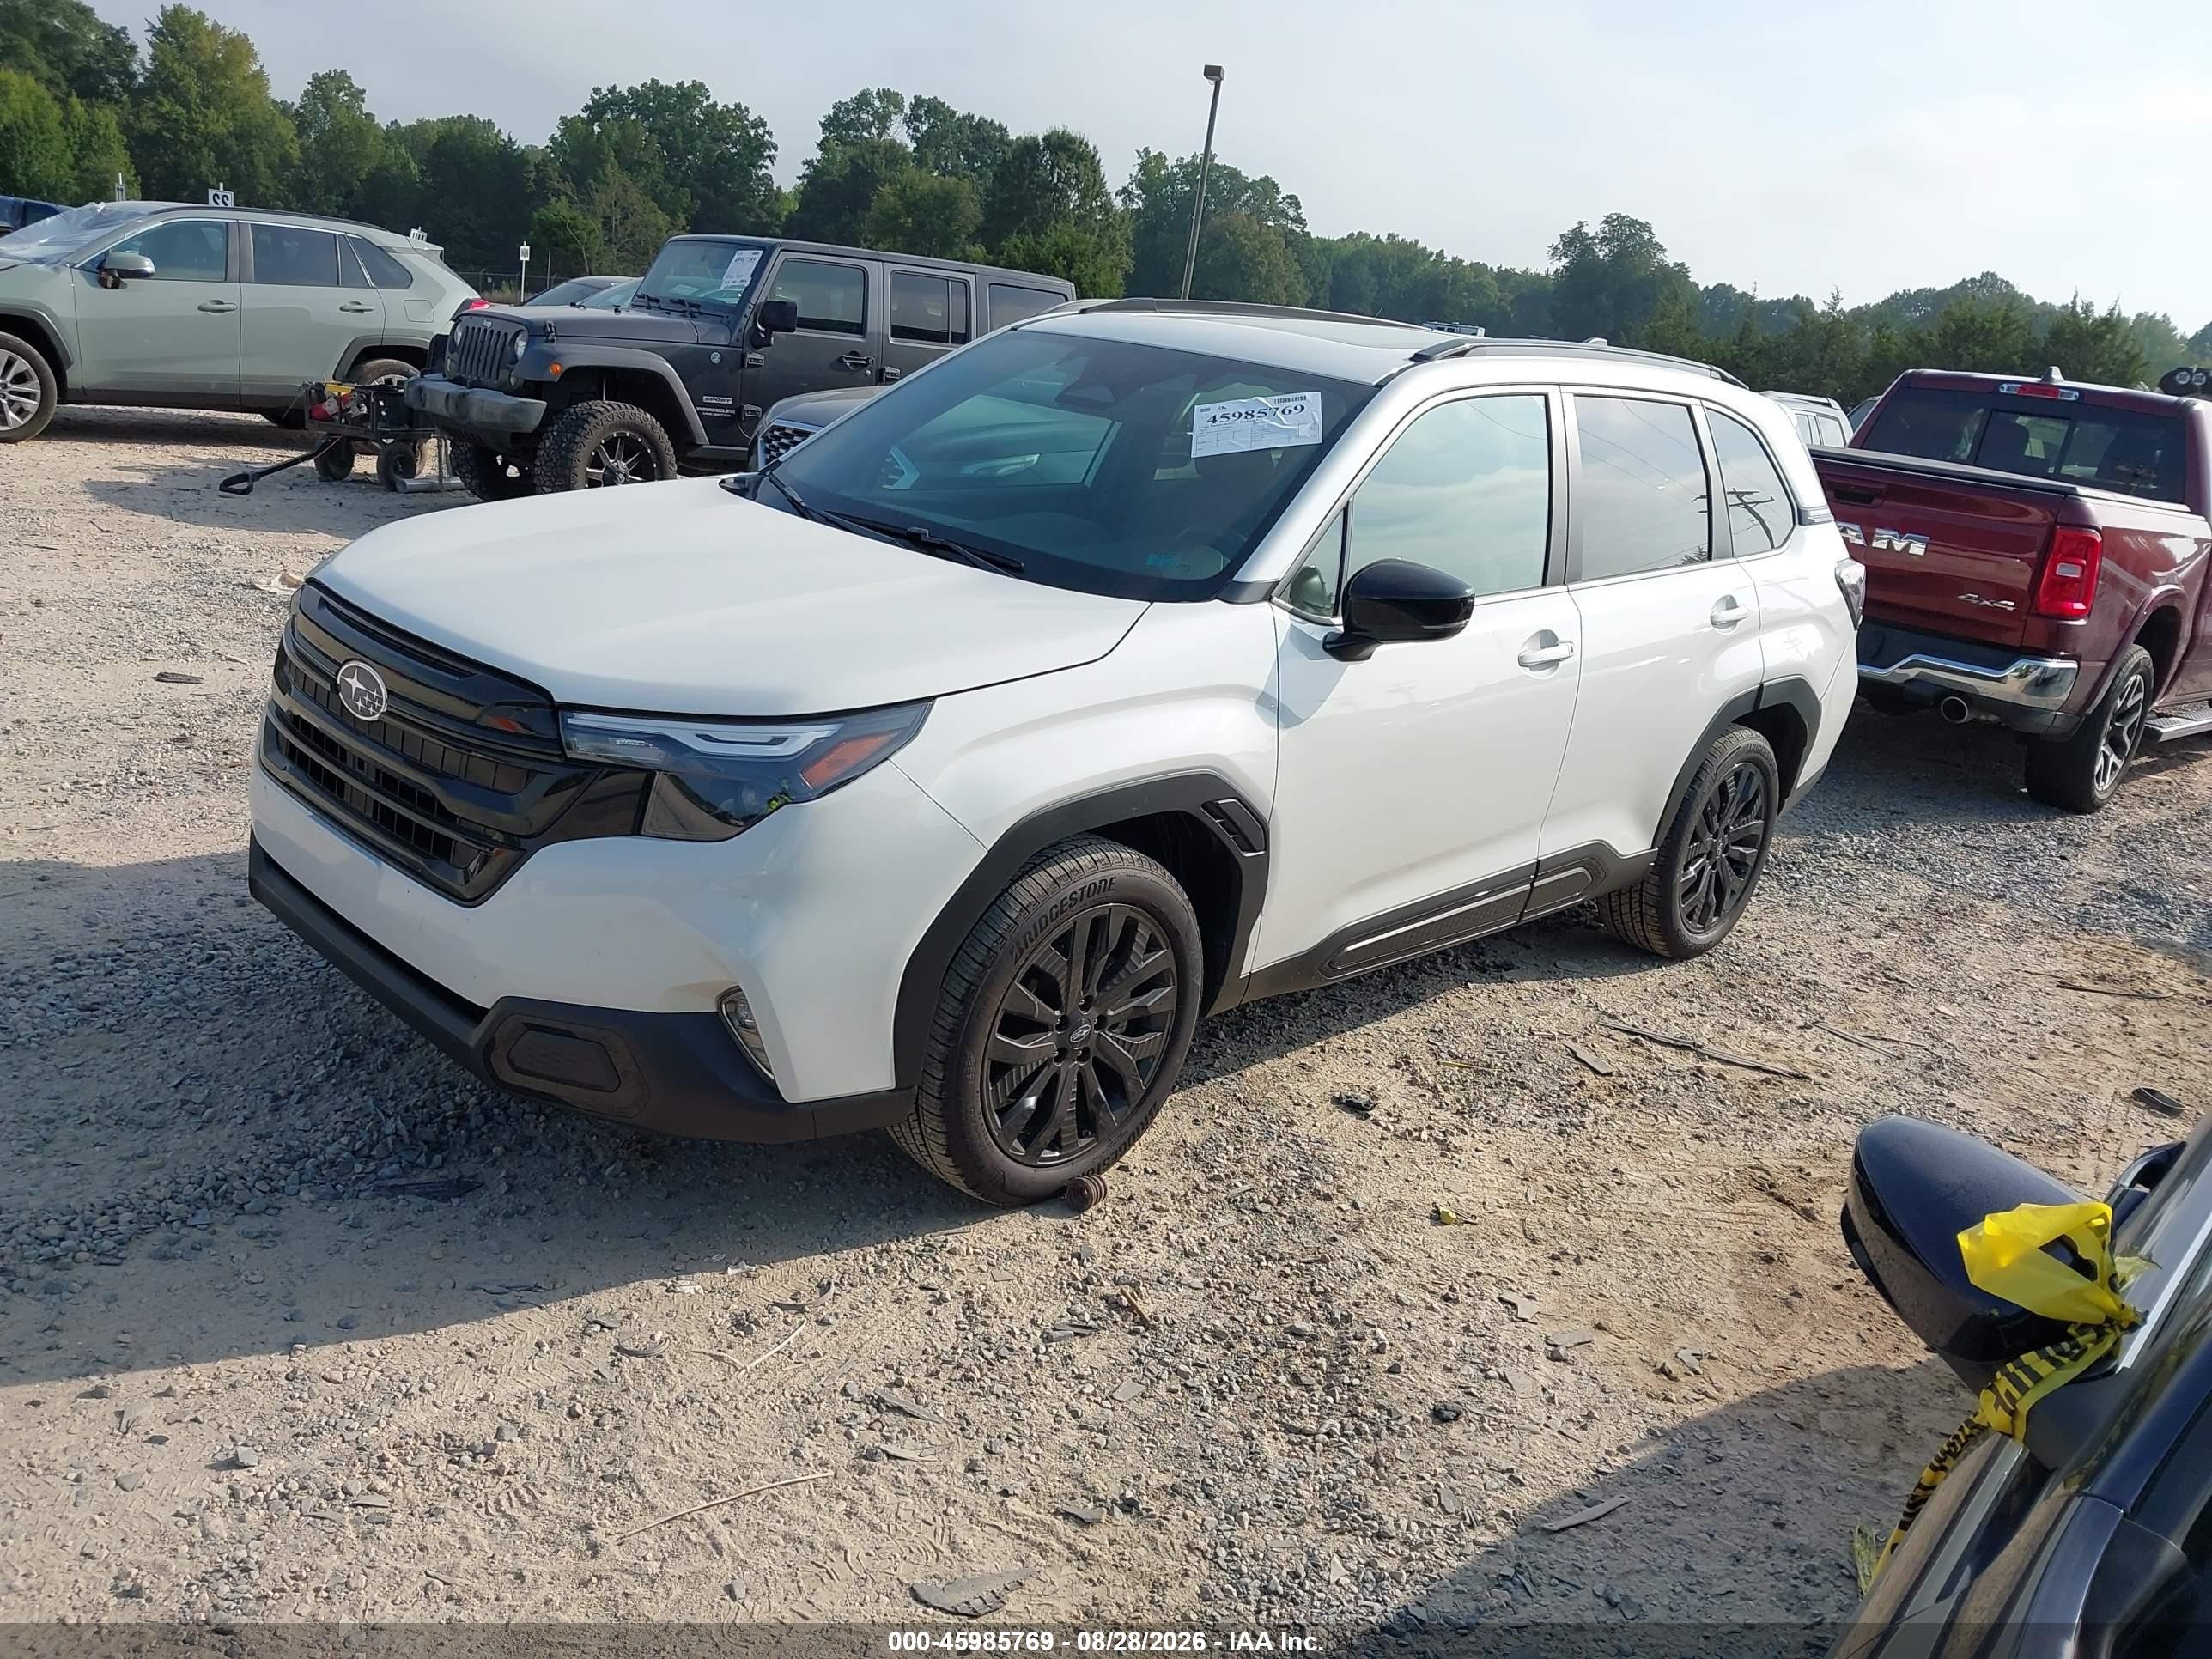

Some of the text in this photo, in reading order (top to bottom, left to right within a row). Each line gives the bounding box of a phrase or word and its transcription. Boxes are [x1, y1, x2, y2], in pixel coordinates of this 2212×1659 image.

[1206, 404, 1306, 424] 45985769
[1835, 520, 1931, 556] AM
[1010, 876, 1118, 964] BRIDGESTONE
